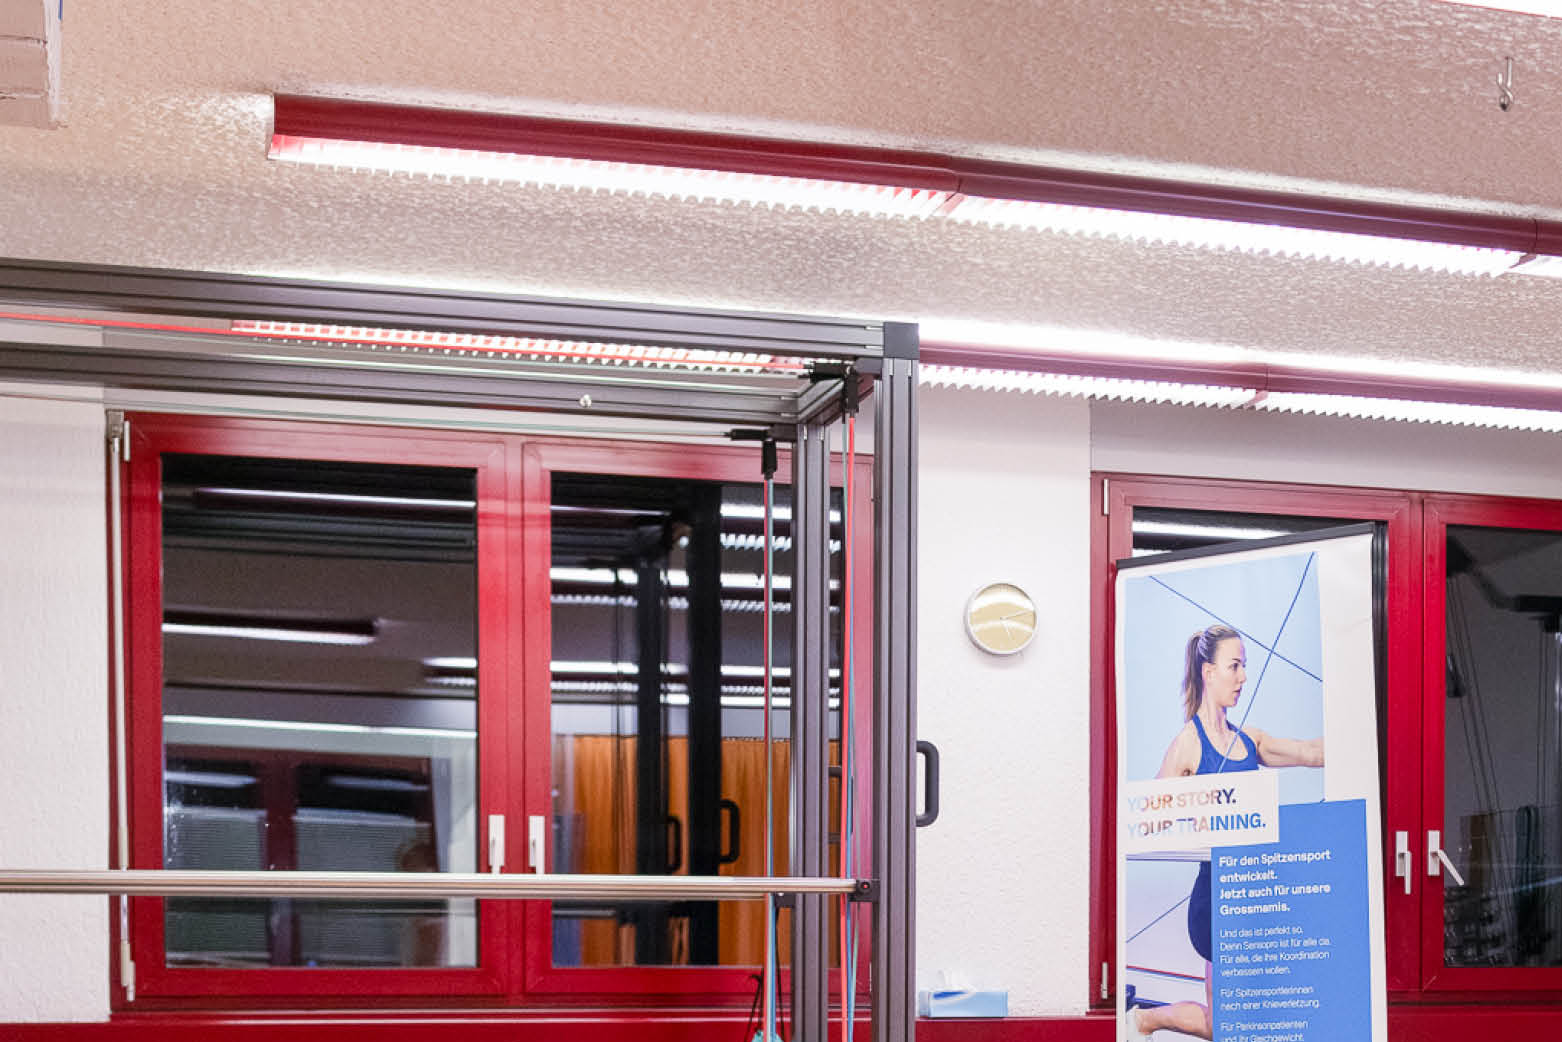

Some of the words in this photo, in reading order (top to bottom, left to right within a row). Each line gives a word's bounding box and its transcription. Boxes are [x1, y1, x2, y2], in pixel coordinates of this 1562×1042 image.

[1127, 794, 1173, 813] YOUR
[1176, 788, 1237, 807] STORY.
[1127, 819, 1173, 838] YOUR
[1176, 812, 1266, 833] TRAINING.
[1219, 856, 1237, 867] Für
[1240, 855, 1259, 866] den
[1262, 849, 1331, 866] Spitzensport
[1219, 869, 1278, 883] entwickelt.
[1220, 887, 1246, 899] Jetzt
[1248, 886, 1272, 898] auch
[1274, 885, 1289, 896] für
[1292, 883, 1331, 895] unsere
[1220, 902, 1290, 916] Grossmamis.
[1220, 988, 1233, 998] Für
[1221, 1022, 1235, 1031] Für
